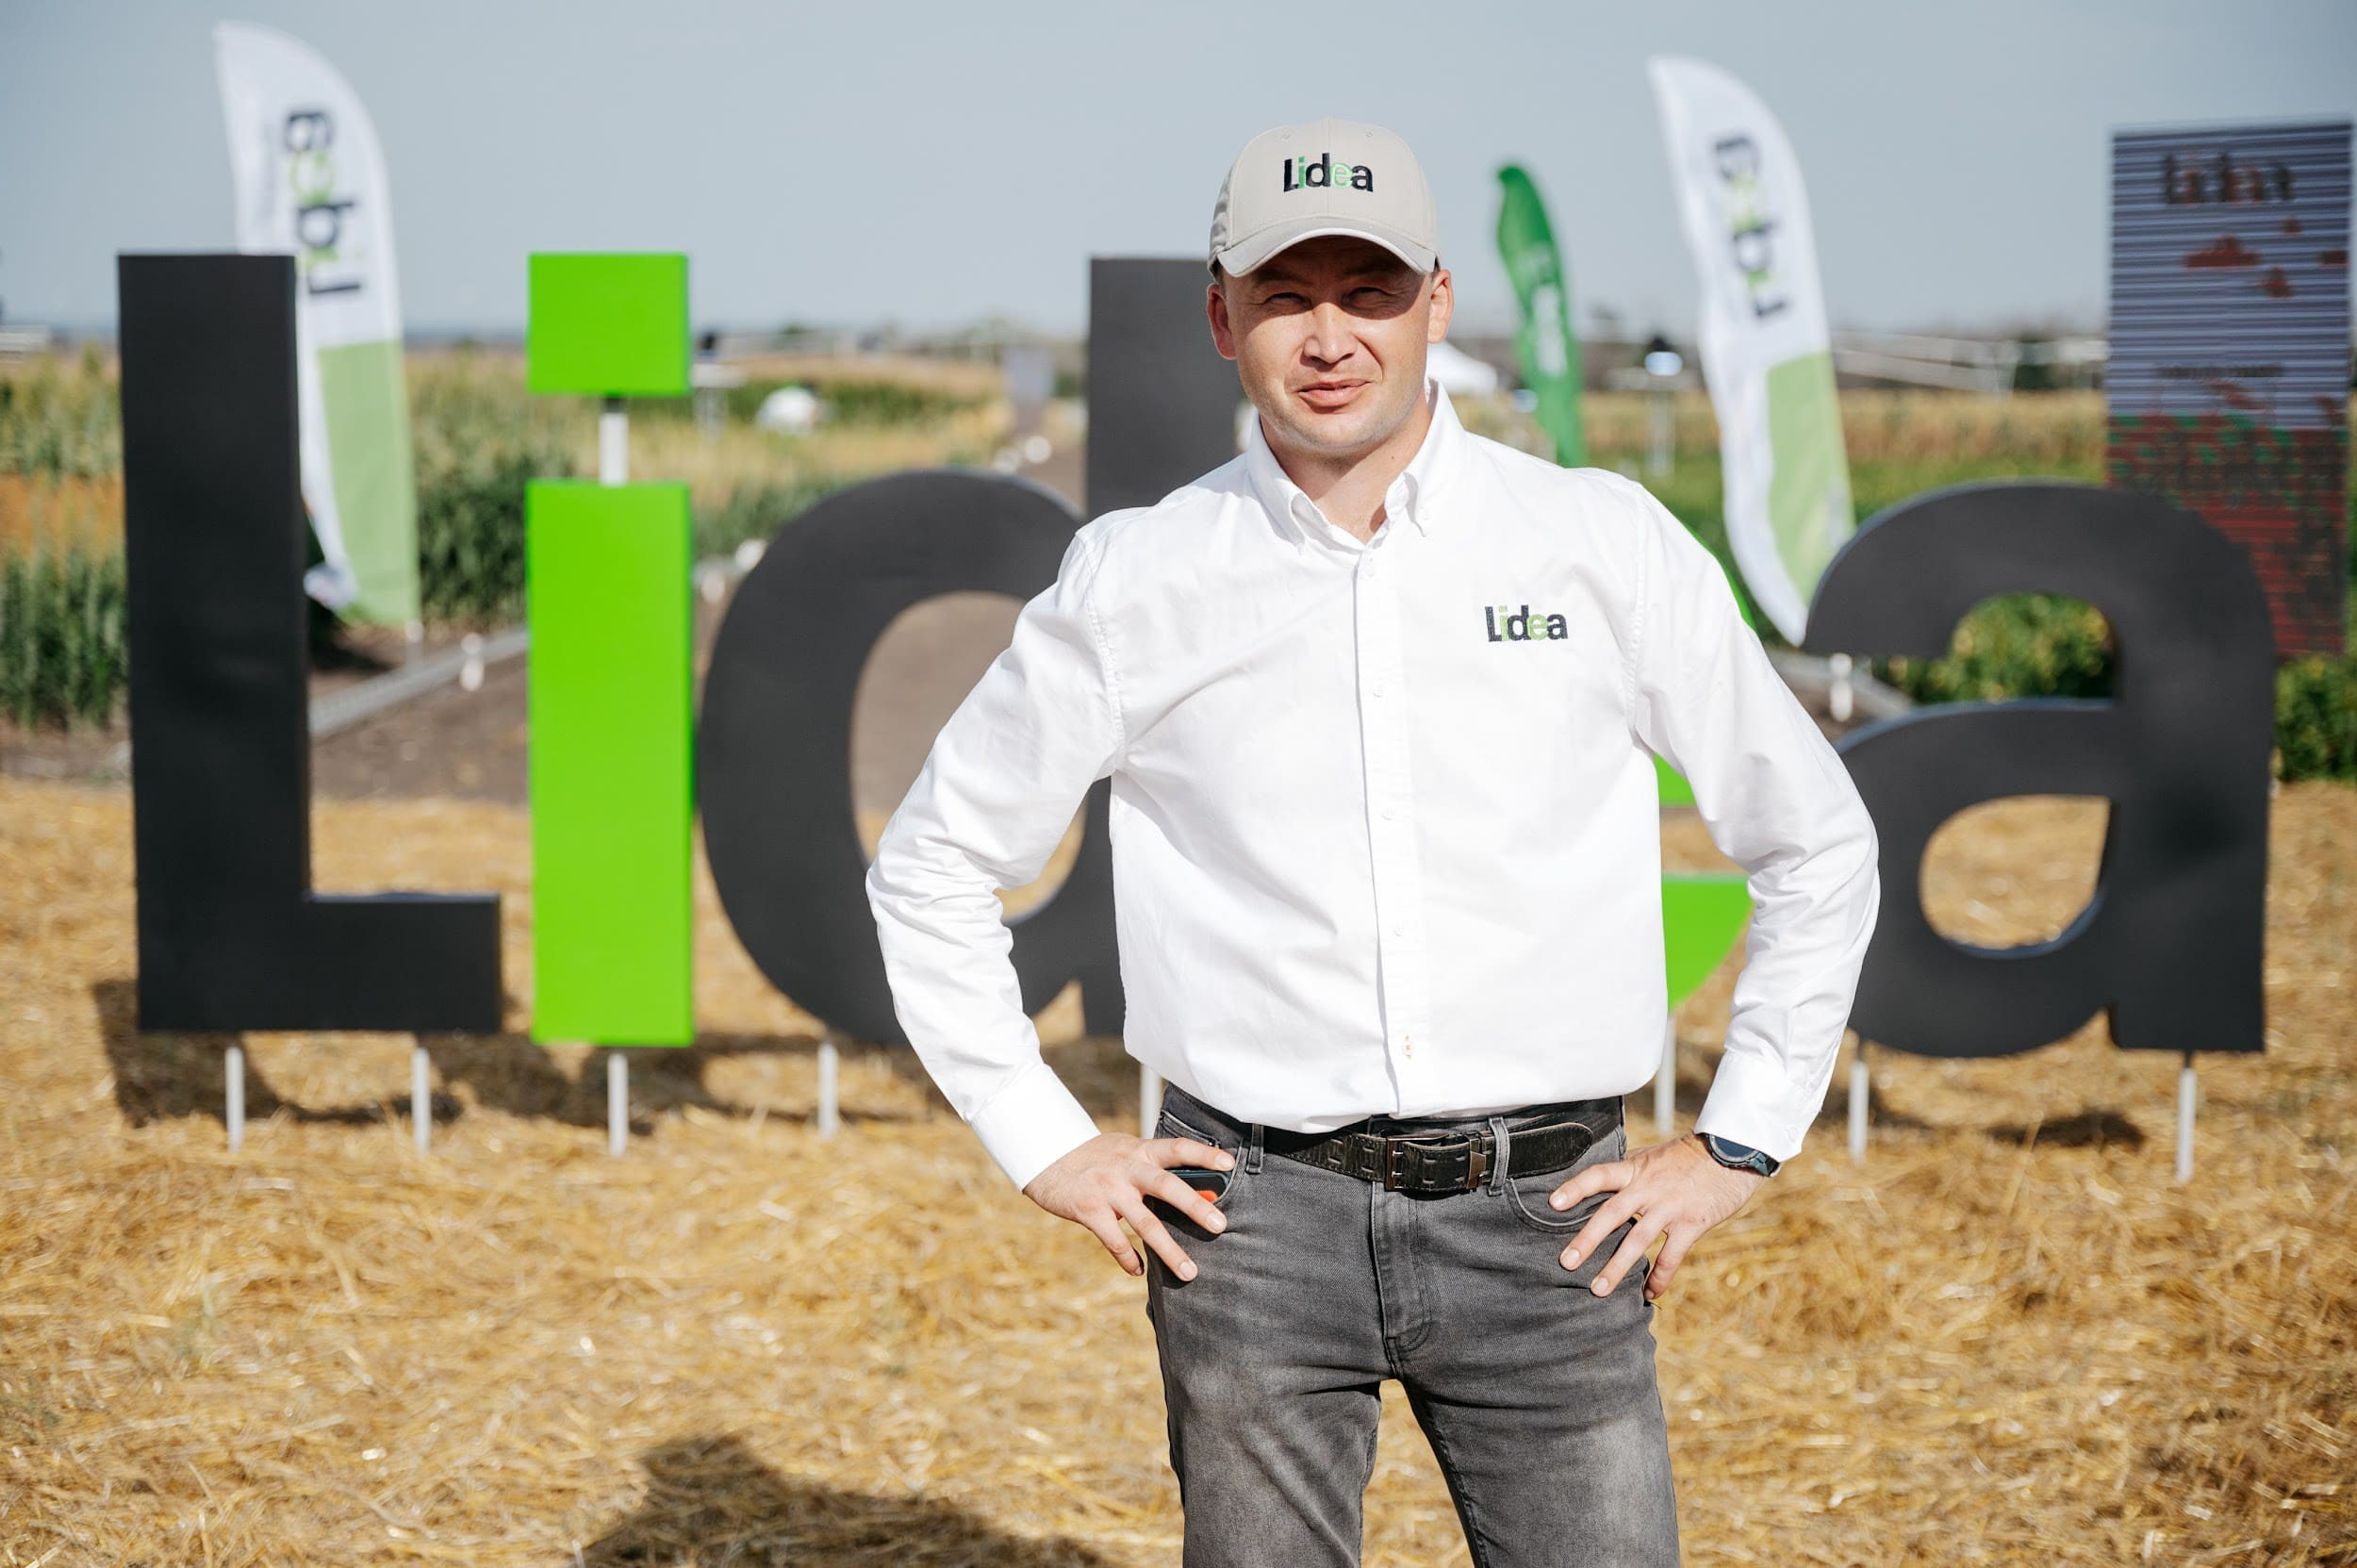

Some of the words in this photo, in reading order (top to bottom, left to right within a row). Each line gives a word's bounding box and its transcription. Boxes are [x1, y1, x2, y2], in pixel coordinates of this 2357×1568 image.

[1283, 152, 1374, 193] Lidea
[1484, 604, 1569, 642] Lidea
[117, 252, 2275, 1058] Lida
